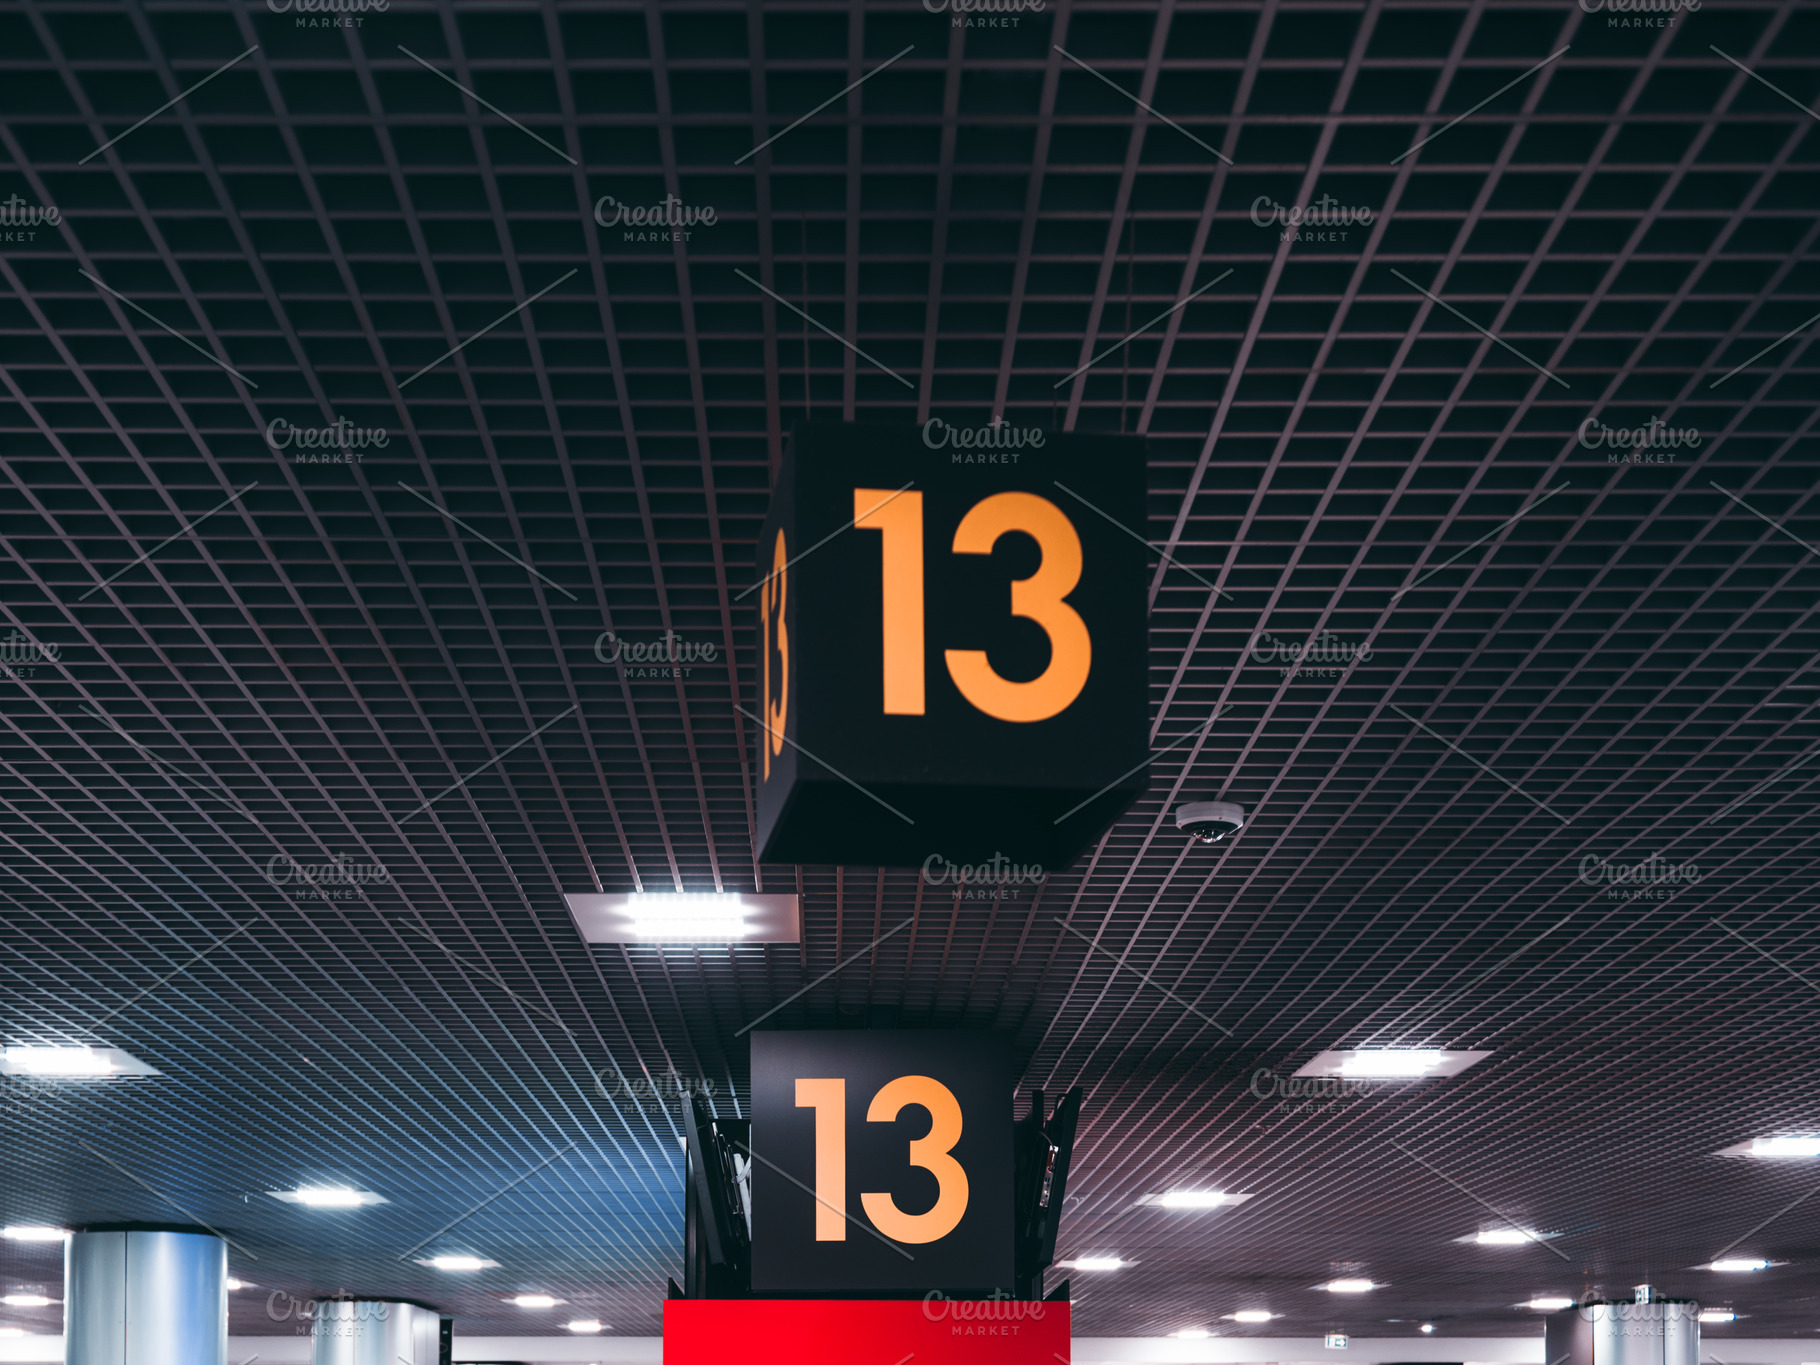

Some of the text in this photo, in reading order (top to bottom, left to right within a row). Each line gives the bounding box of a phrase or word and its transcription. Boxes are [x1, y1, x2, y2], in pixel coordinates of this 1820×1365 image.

[761, 528, 789, 783] 13
[854, 488, 1091, 723] 13
[795, 1075, 969, 1244] 13
